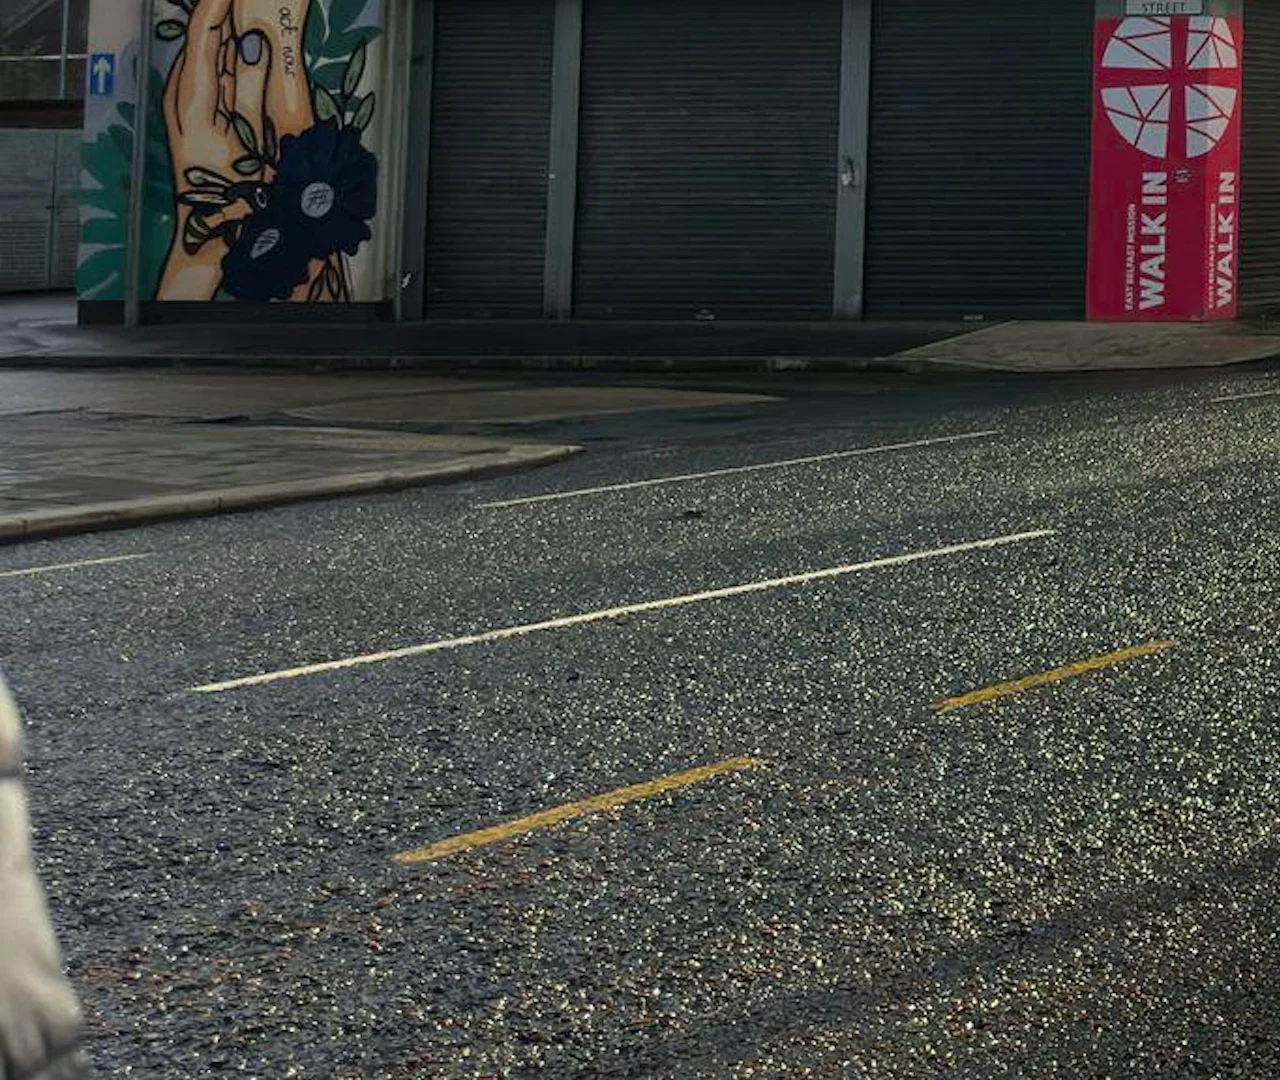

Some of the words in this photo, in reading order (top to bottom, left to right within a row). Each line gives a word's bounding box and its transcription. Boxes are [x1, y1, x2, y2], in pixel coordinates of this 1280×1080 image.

[279, 7, 299, 37] act
[1141, 2, 1185, 14] STREET
[283, 46, 296, 78] now
[1141, 171, 1168, 205] IN
[1218, 171, 1236, 204] IN
[1126, 203, 1136, 243] MISSION
[1125, 245, 1136, 285] BELFAST
[1138, 211, 1167, 311] WALK
[1216, 211, 1234, 308] WALK
[1124, 286, 1134, 311] EAST
